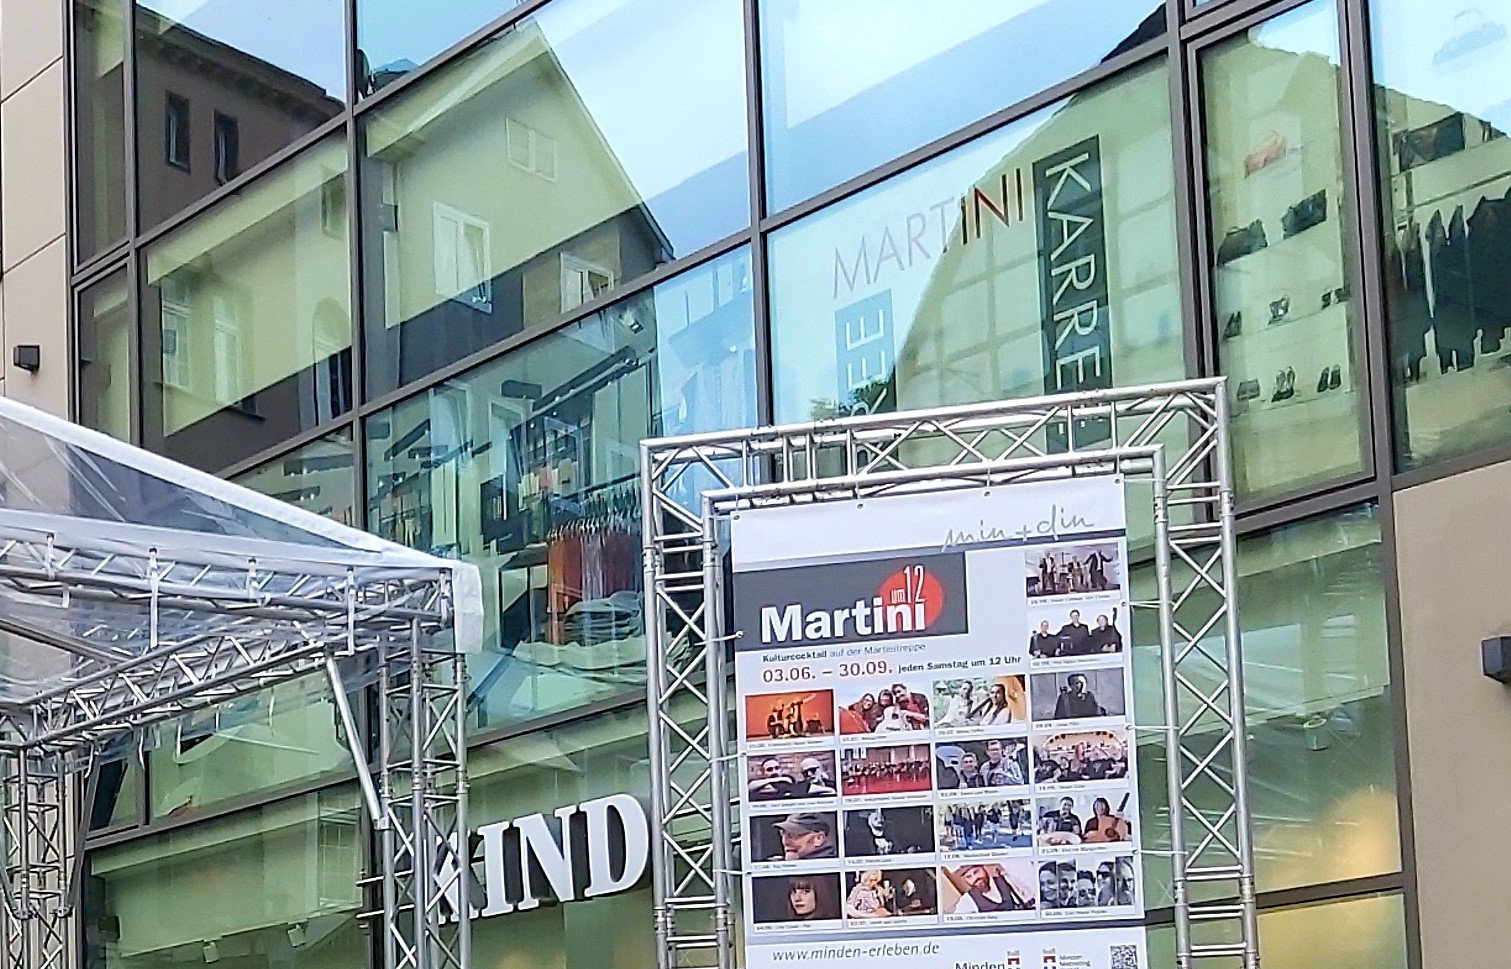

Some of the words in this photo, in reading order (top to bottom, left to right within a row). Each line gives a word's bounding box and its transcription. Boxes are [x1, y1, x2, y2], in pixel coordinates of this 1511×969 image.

[833, 167, 1024, 300] MARTINI
[1046, 152, 1102, 424] KARRE
[941, 519, 1005, 552] min
[1037, 504, 1095, 541] din
[890, 588, 905, 605] um
[903, 565, 925, 604] 12
[761, 596, 926, 643] Martini
[762, 666, 816, 683] 03.06.
[839, 660, 893, 677] 30.09.
[898, 664, 924, 674] jeden
[927, 659, 969, 671] Samstag
[971, 659, 986, 667] um
[989, 656, 1002, 666] 12
[1004, 655, 1021, 664] Uhr
